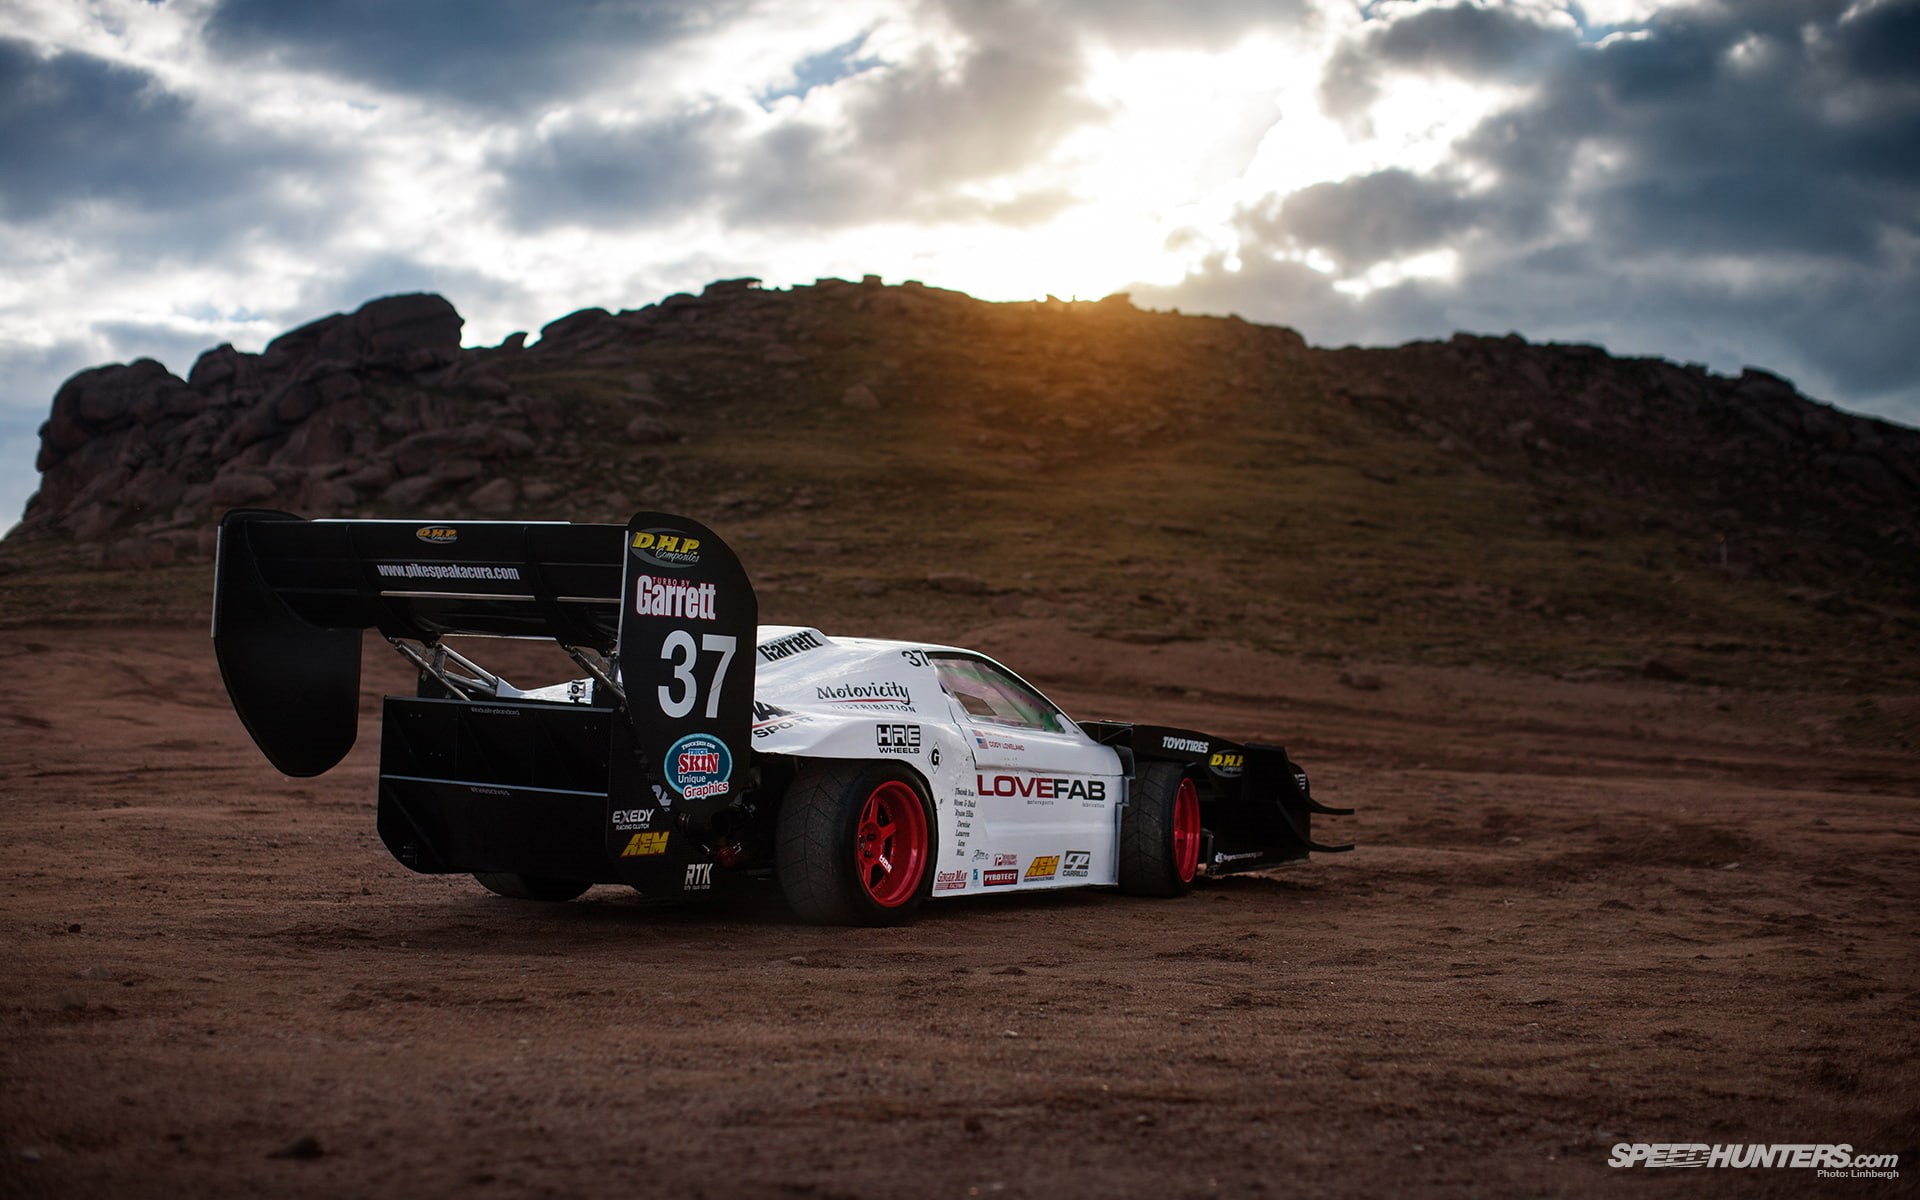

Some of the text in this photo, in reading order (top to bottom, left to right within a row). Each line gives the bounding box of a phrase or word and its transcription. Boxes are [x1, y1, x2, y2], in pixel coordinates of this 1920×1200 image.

[631, 531, 700, 555] D.H.P.
[655, 548, 700, 562] Composites
[377, 563, 520, 580] www.pikespeakacura.com
[653, 576, 678, 586] TURBO
[635, 574, 716, 620] Garrett
[757, 631, 824, 662] Garrett
[901, 649, 931, 668] 37
[657, 629, 737, 719] 37
[816, 681, 911, 706] Motovicity
[831, 703, 917, 713] DISTRIBUTION
[876, 724, 921, 746] HRE
[1162, 736, 1209, 754] TOYO TIRES
[678, 752, 719, 774] SKIN
[931, 748, 940, 766] G
[678, 774, 706, 784] Unique
[977, 774, 1106, 801] LOVEFAB
[683, 780, 730, 799] Graphics
[612, 808, 655, 824] EXEDY
[620, 831, 670, 857] AEM
[684, 863, 714, 886] RTK
[1025, 855, 1060, 877] AEM
[1063, 870, 1088, 878] CARRILLO
[984, 872, 1017, 881] PYROTECT
